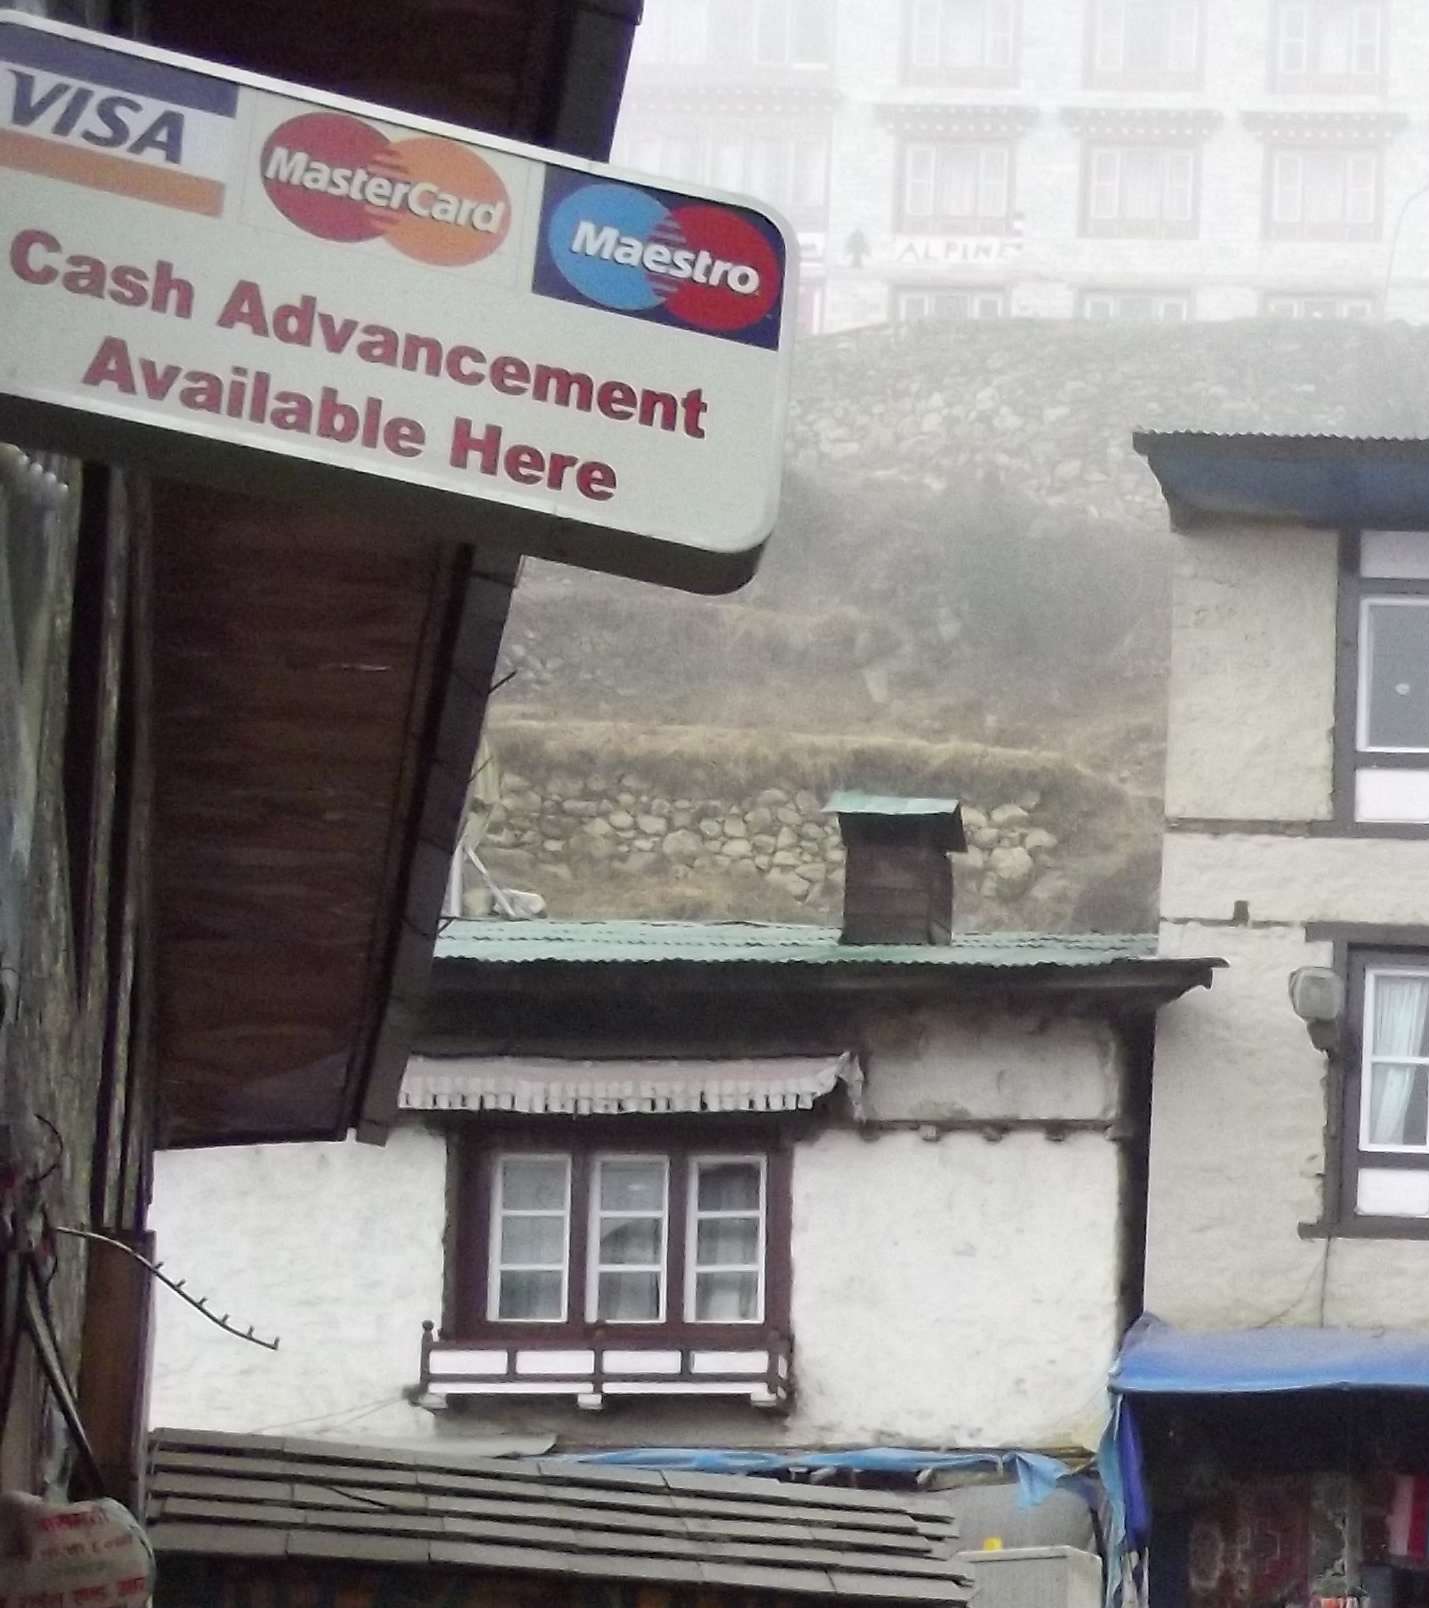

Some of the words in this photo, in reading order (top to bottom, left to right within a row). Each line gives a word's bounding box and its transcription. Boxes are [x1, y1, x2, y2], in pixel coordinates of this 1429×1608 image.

[3, 62, 187, 166] VISA
[265, 144, 507, 237] MasterCard
[569, 220, 762, 297] Maestro
[8, 228, 194, 320] Cash
[216, 280, 709, 441] Advancement
[83, 336, 428, 460] Available
[449, 416, 619, 503] Here
